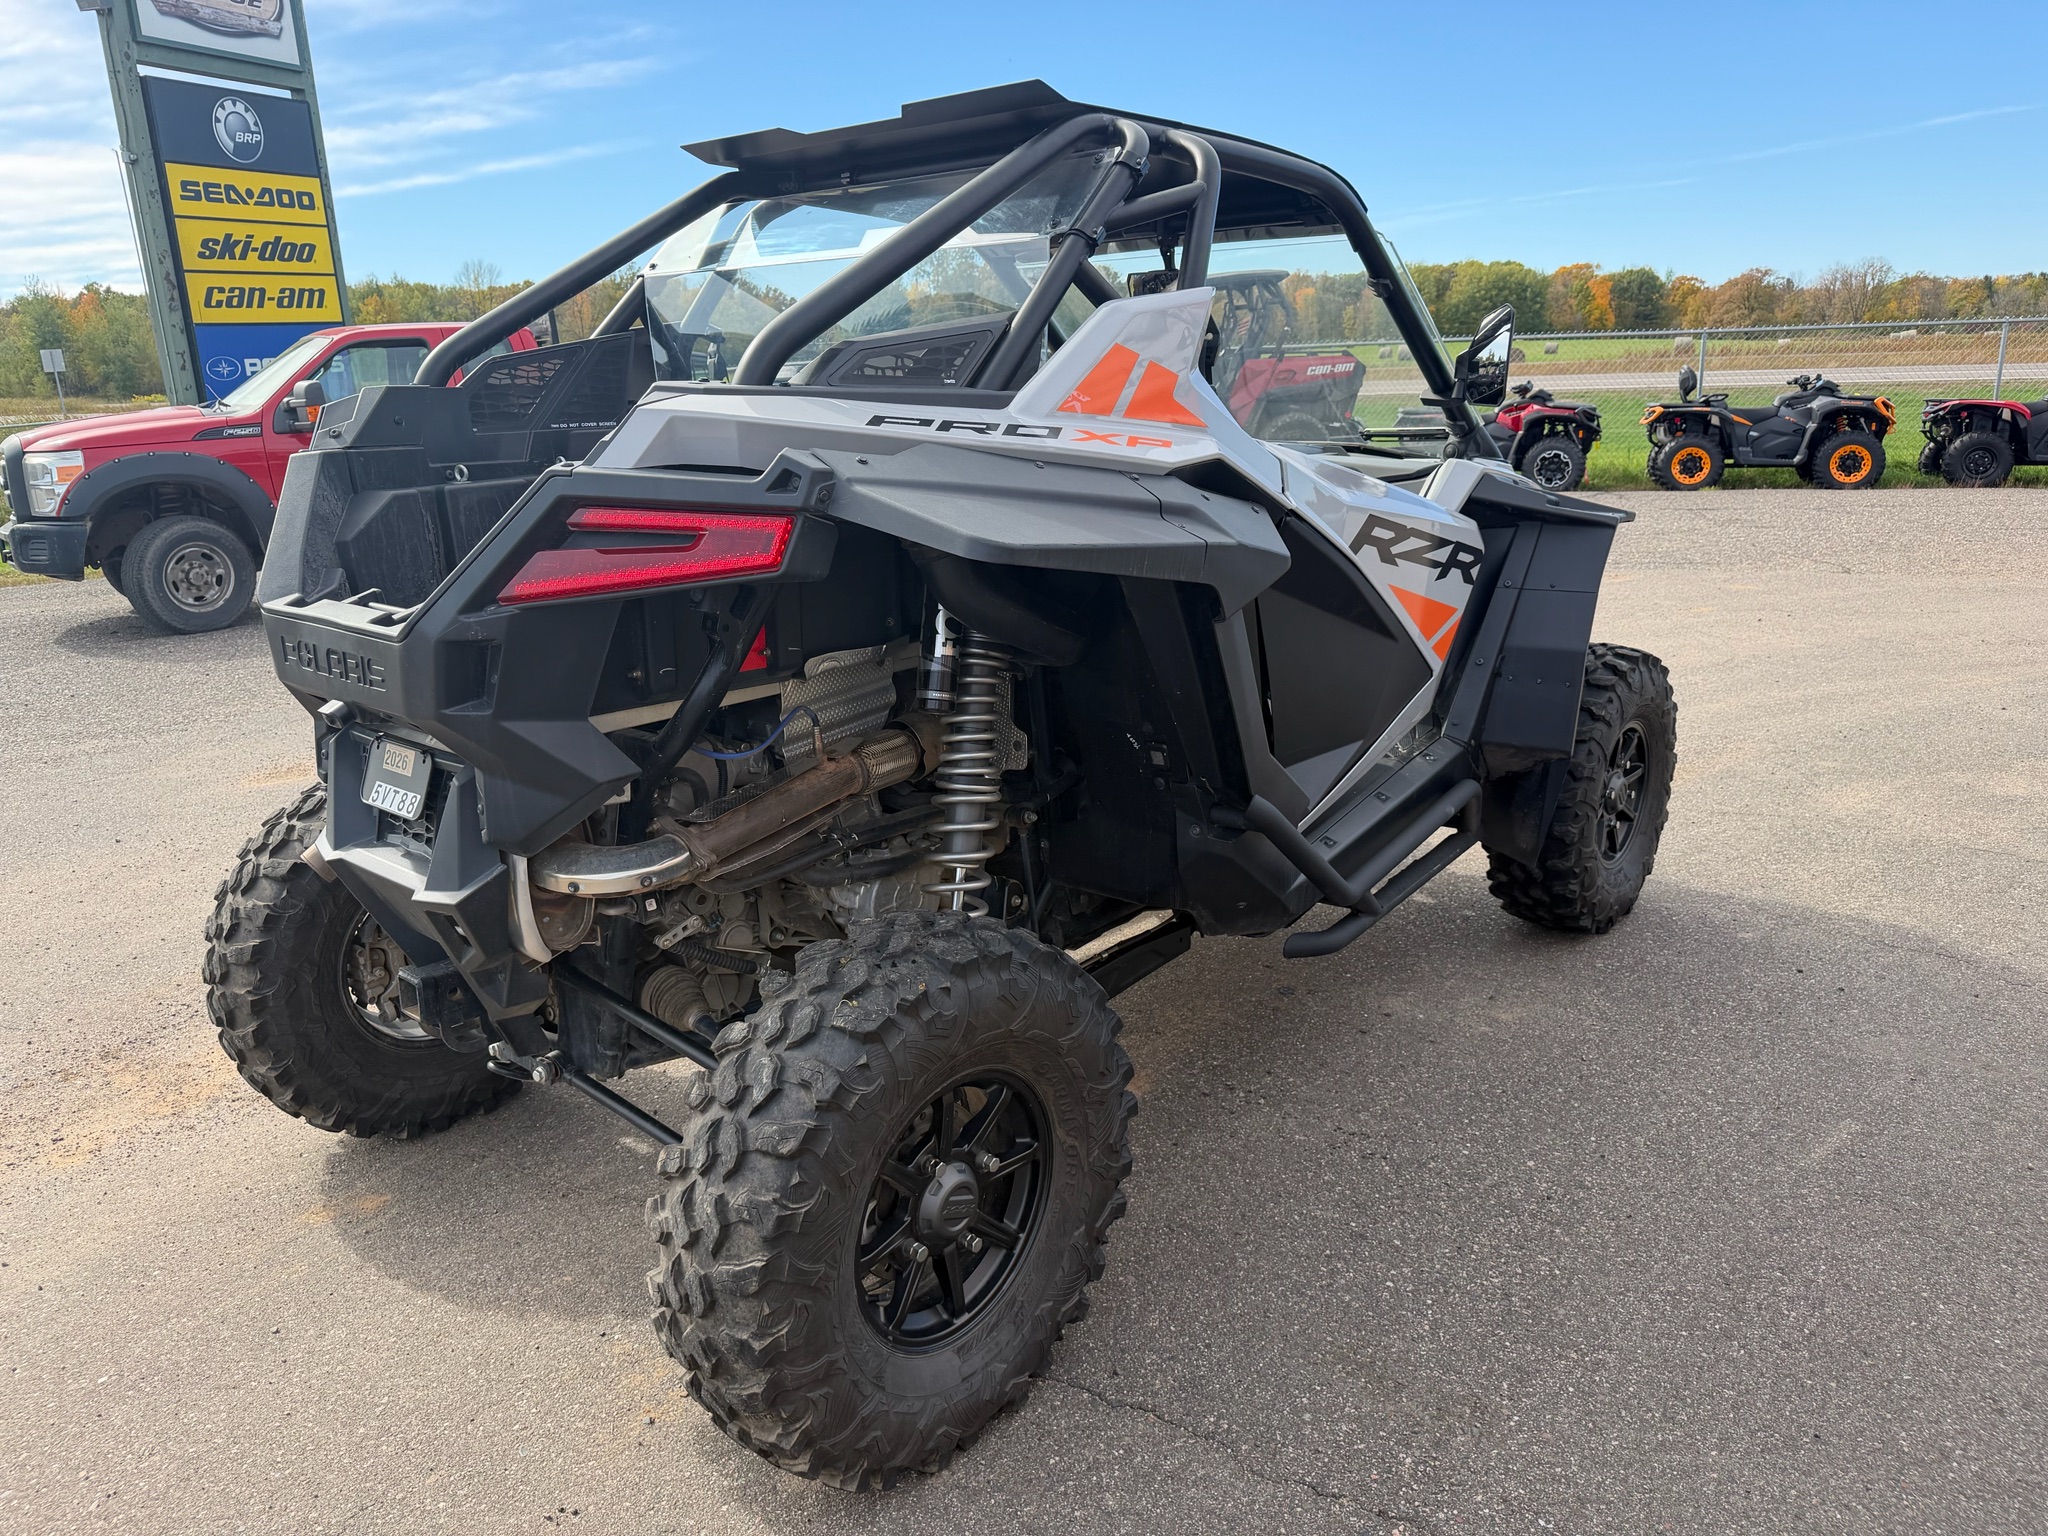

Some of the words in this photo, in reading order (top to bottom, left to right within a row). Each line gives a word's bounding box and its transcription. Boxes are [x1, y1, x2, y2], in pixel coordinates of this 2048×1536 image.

[235, 130, 262, 145] BRP
[197, 232, 317, 264] ski-doo
[203, 285, 326, 310] can-am
[1306, 362, 1355, 376] can-am
[865, 414, 1063, 440] PRO
[1070, 428, 1173, 449] XP
[1349, 513, 1484, 586] RZR
[280, 635, 387, 692] POLARIS
[384, 749, 409, 771] 2026
[371, 783, 418, 815] 5VT88
